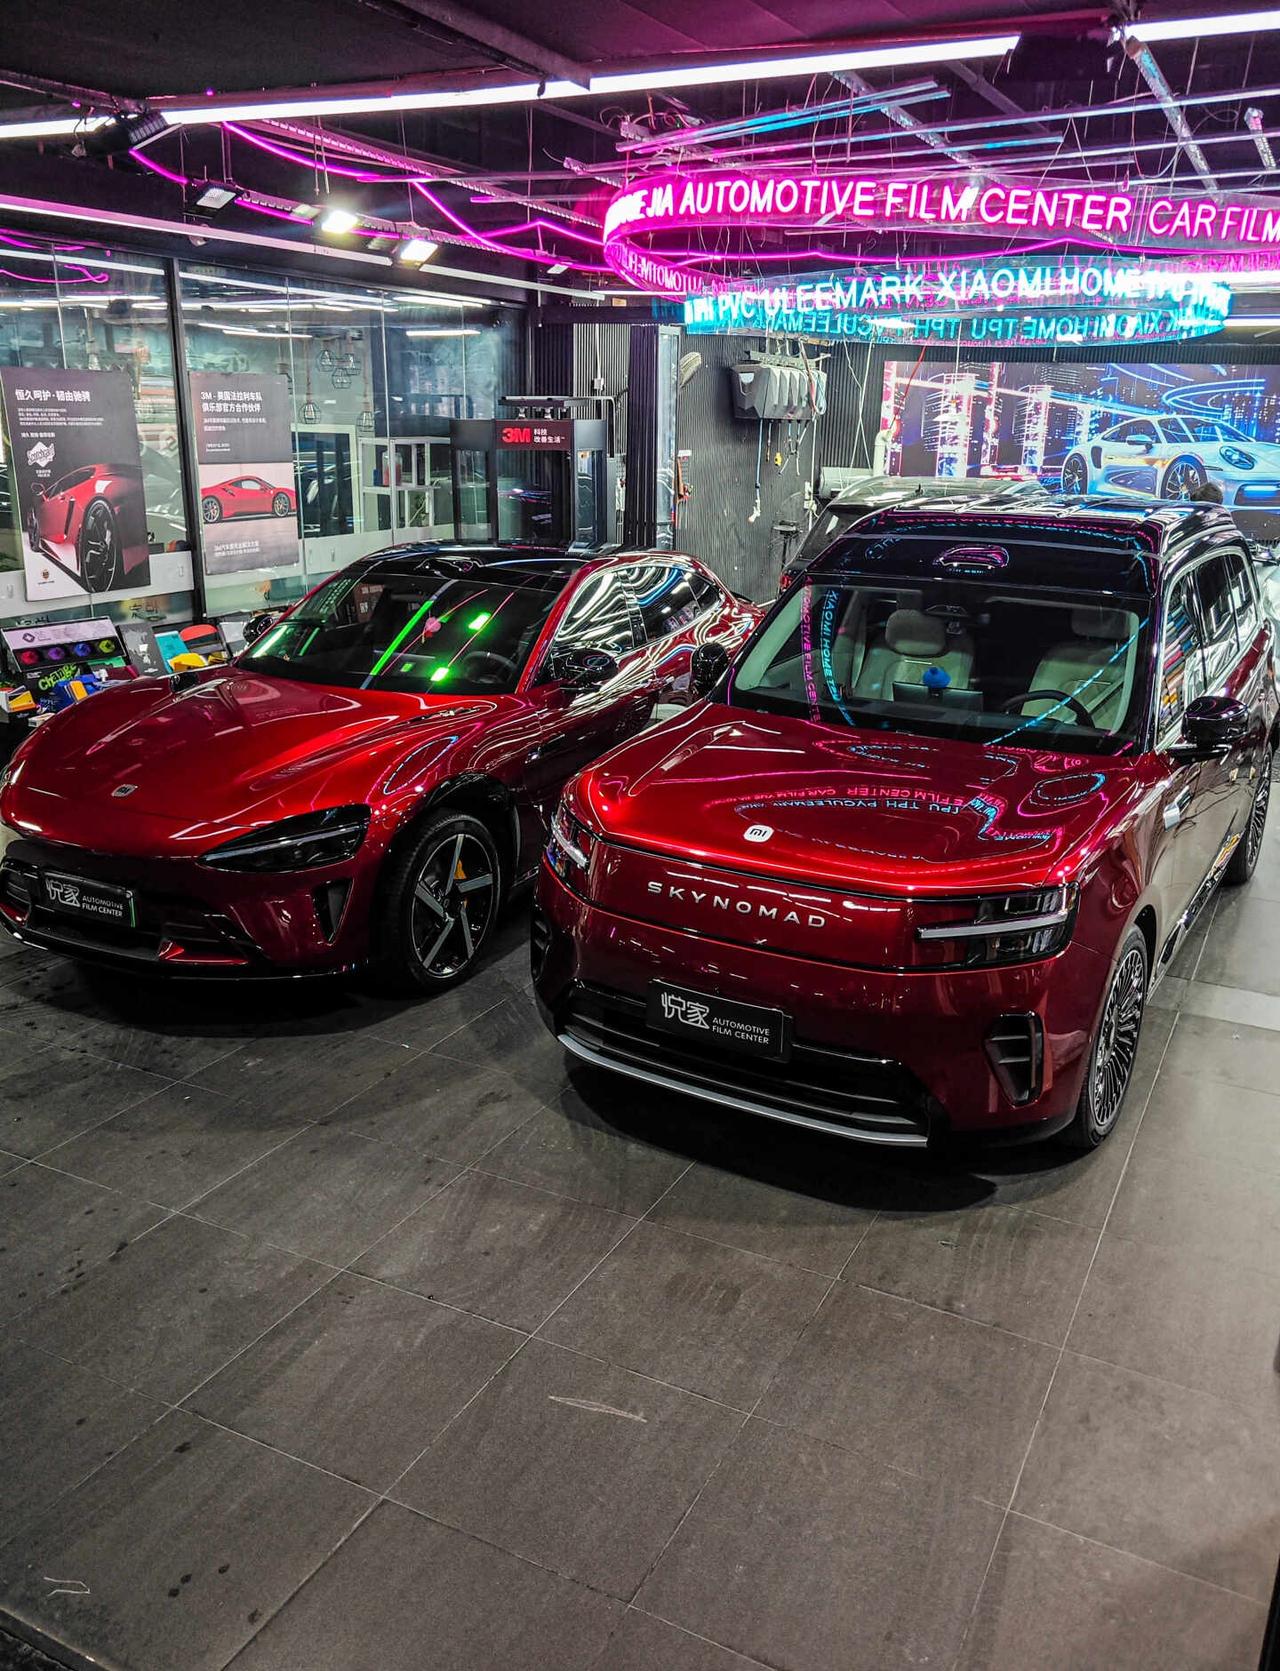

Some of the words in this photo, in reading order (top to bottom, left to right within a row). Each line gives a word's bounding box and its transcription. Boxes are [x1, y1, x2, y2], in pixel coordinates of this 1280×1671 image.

[678, 178, 876, 217] AUTOMOTIVE
[885, 182, 978, 221] FILM
[980, 187, 1132, 232] CENTER
[1149, 200, 1216, 238] CAR
[936, 268, 1052, 301] XIAOMI
[502, 427, 531, 444] 3M
[38, 662, 78, 692] Change
[81, 903, 97, 913] FILM
[98, 906, 123, 918] CENTER
[82, 895, 124, 911] AUTOMOTIVE
[647, 880, 827, 929] SKYNOMAD
[661, 992, 710, 1030] 悦家
[712, 1016, 770, 1037] AUTOMOTIVE
[712, 1025, 732, 1037] FILM
[734, 1030, 770, 1046] CENTER
